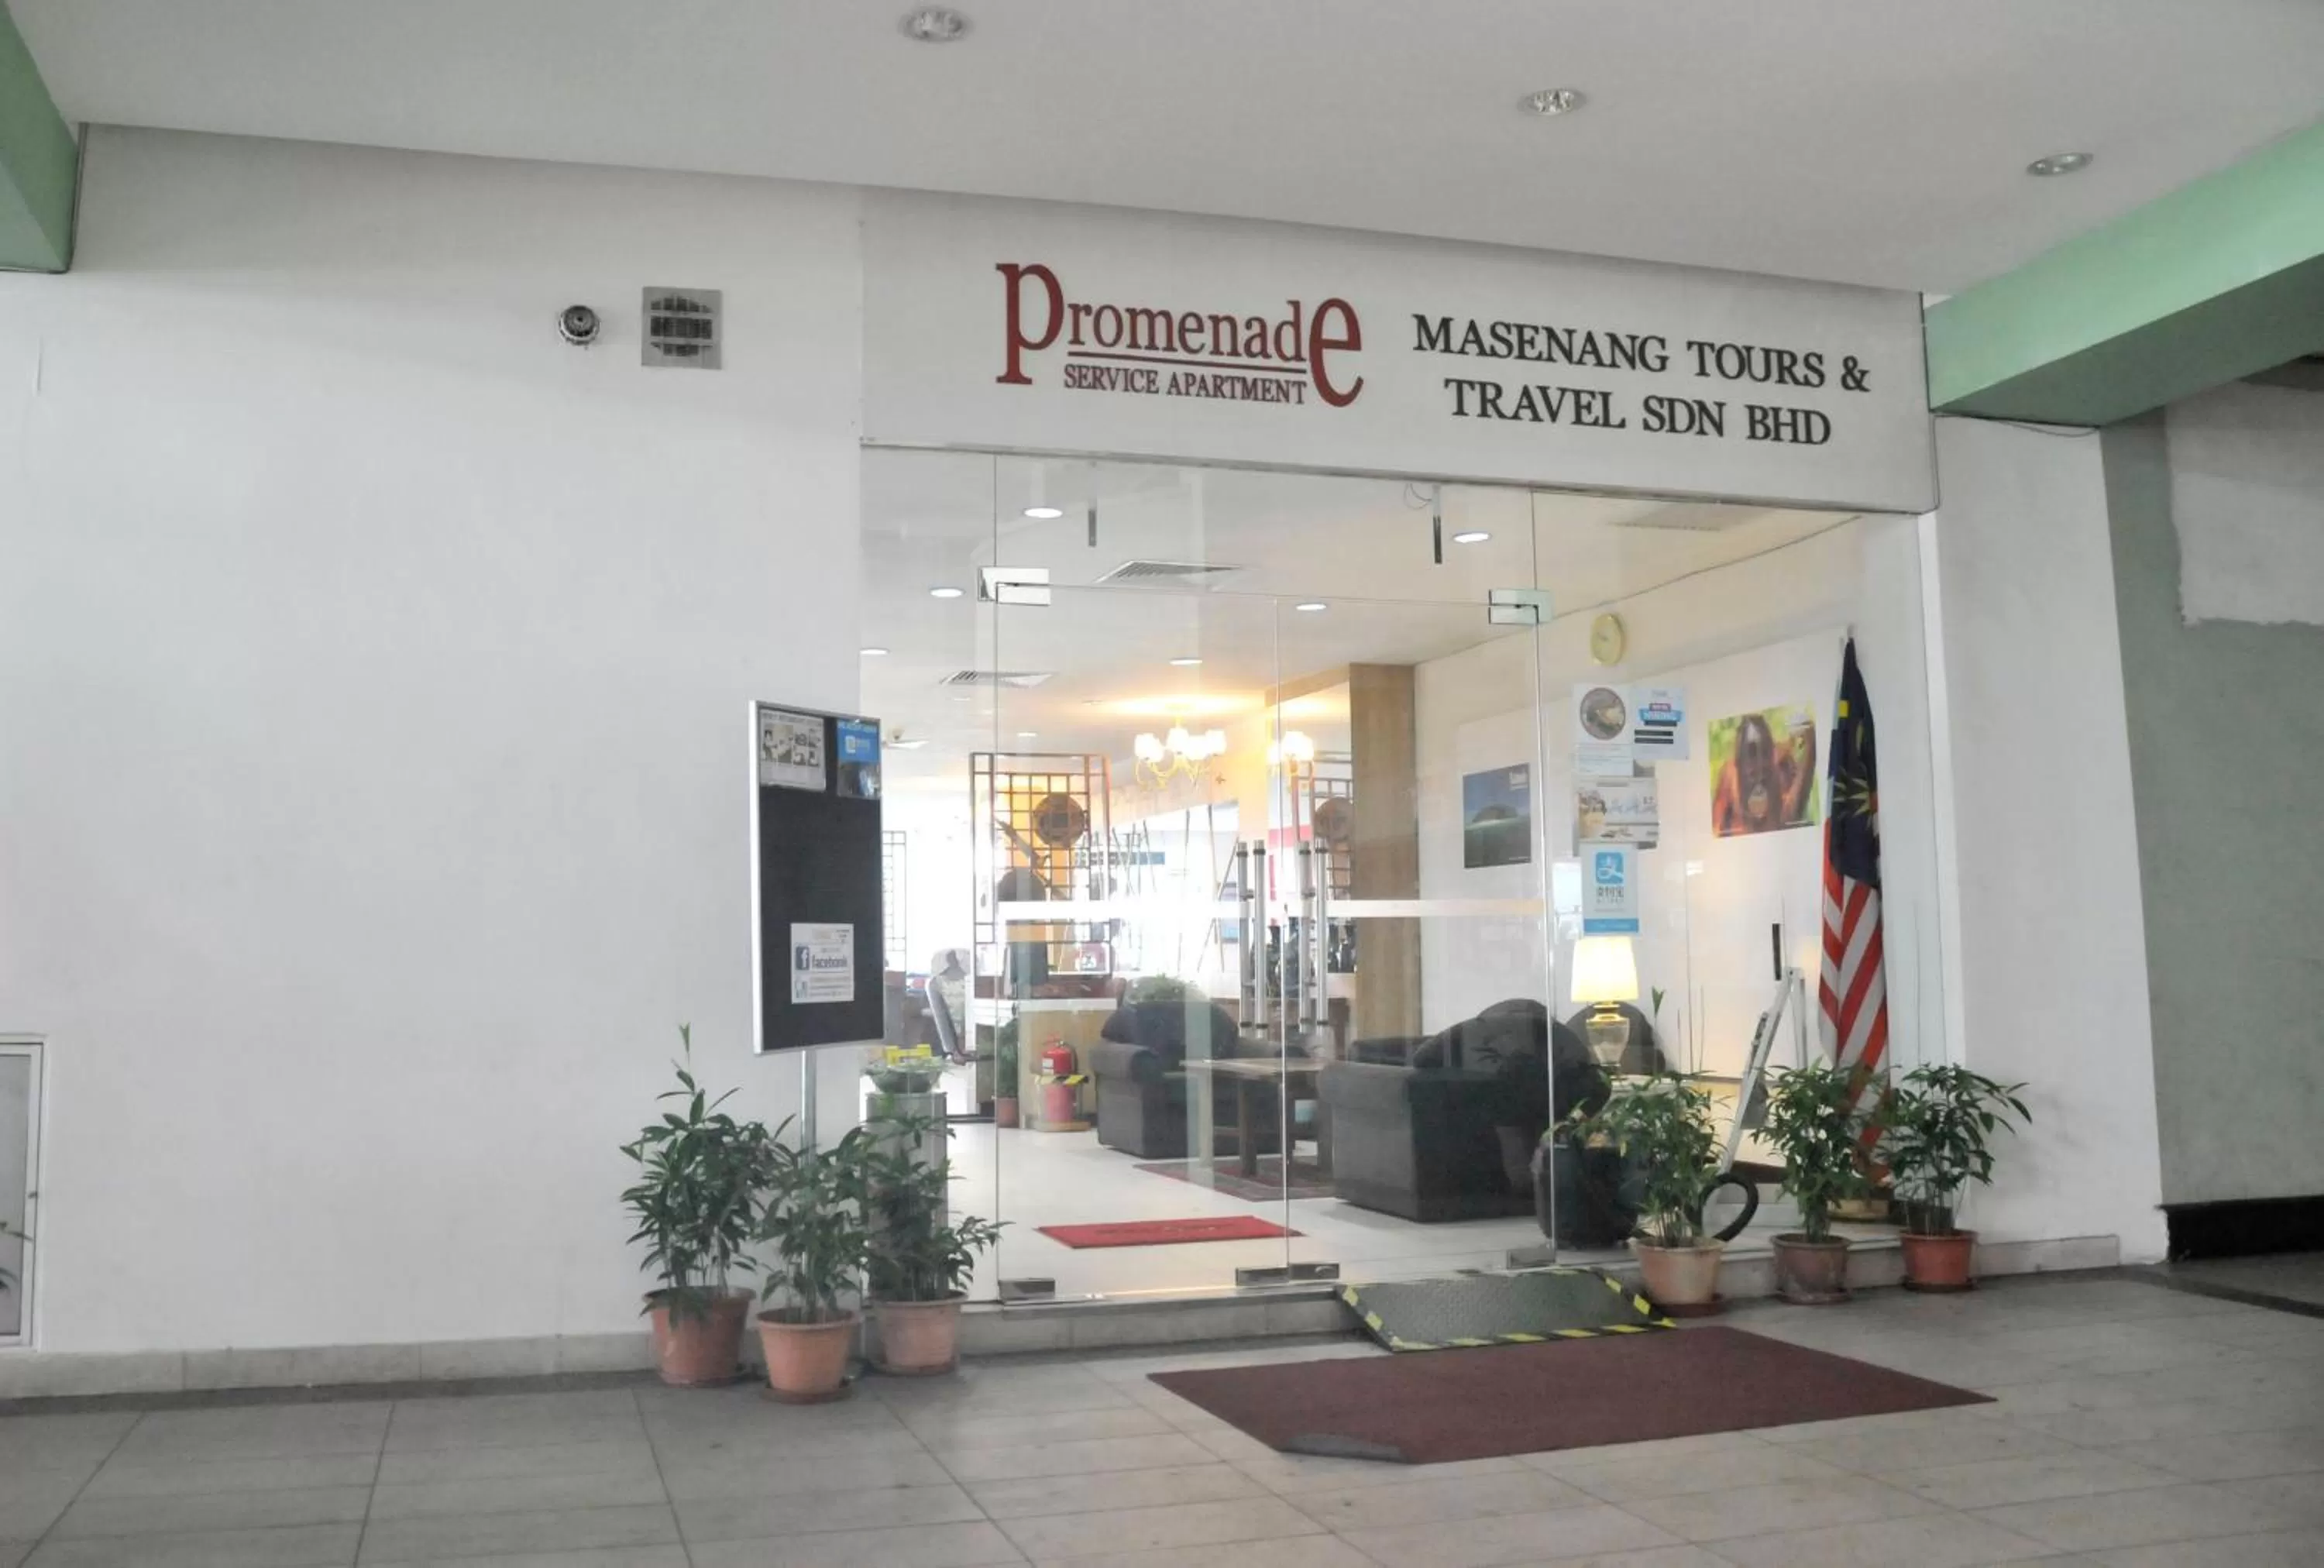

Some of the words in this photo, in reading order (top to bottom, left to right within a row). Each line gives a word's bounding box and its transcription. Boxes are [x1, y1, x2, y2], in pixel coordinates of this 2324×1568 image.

[995, 263, 1363, 407] Promenade
[1412, 314, 1669, 373] MASENANG
[1686, 340, 1825, 387] TOURS
[1841, 356, 1870, 392] &
[1064, 363, 1160, 394] SERVICE
[1166, 372, 1307, 404] APARTMENT
[1444, 378, 1626, 428] TRAVEL
[1642, 395, 1727, 437] SDN
[1745, 404, 1831, 445] BHD
